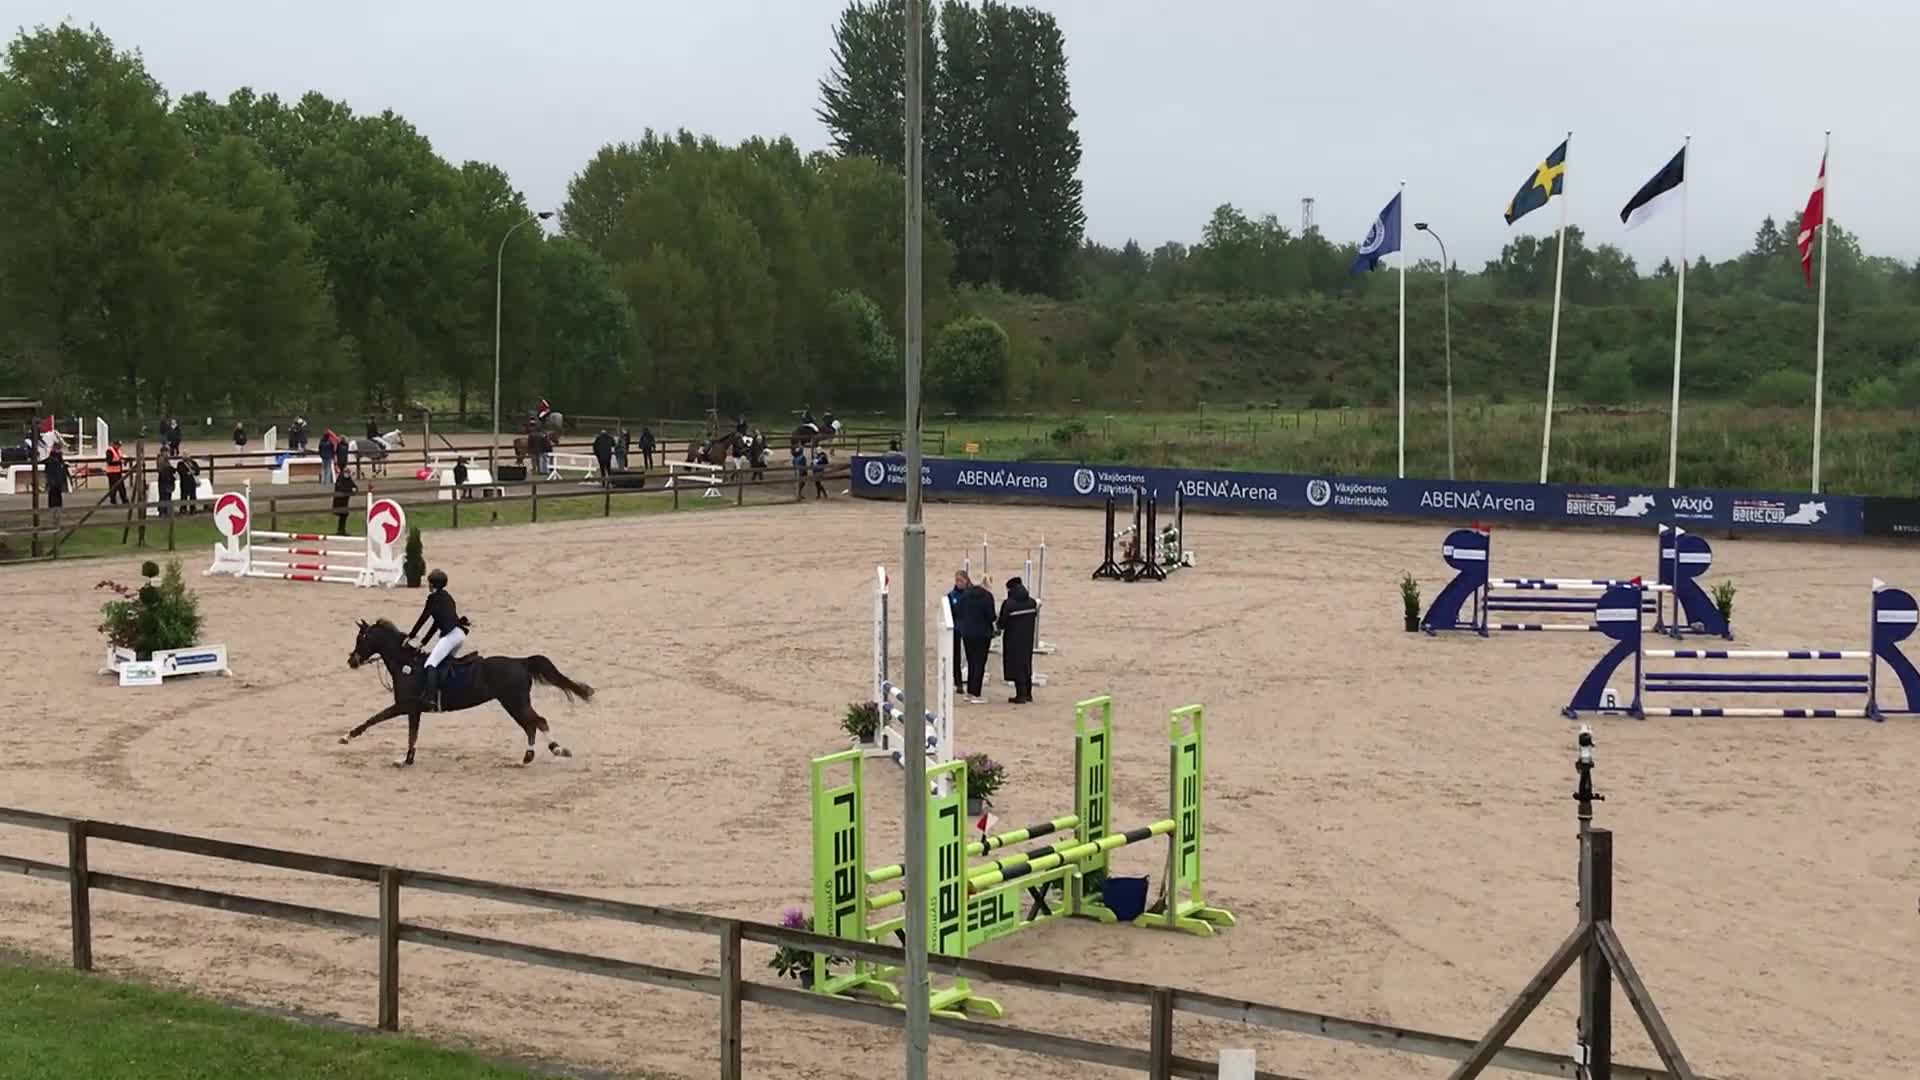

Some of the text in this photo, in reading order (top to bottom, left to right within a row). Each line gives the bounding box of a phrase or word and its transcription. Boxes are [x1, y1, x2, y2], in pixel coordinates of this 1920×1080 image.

[1005, 472, 1048, 489] Arena
[1098, 471, 1145, 483] Växjöortens
[1230, 483, 1278, 501] Arena
[1334, 482, 1388, 495] Växjöortens
[1334, 495, 1389, 507] Fältrittklubb
[1481, 493, 1535, 511] Arena
[1671, 495, 1714, 513] VÄXJÖ
